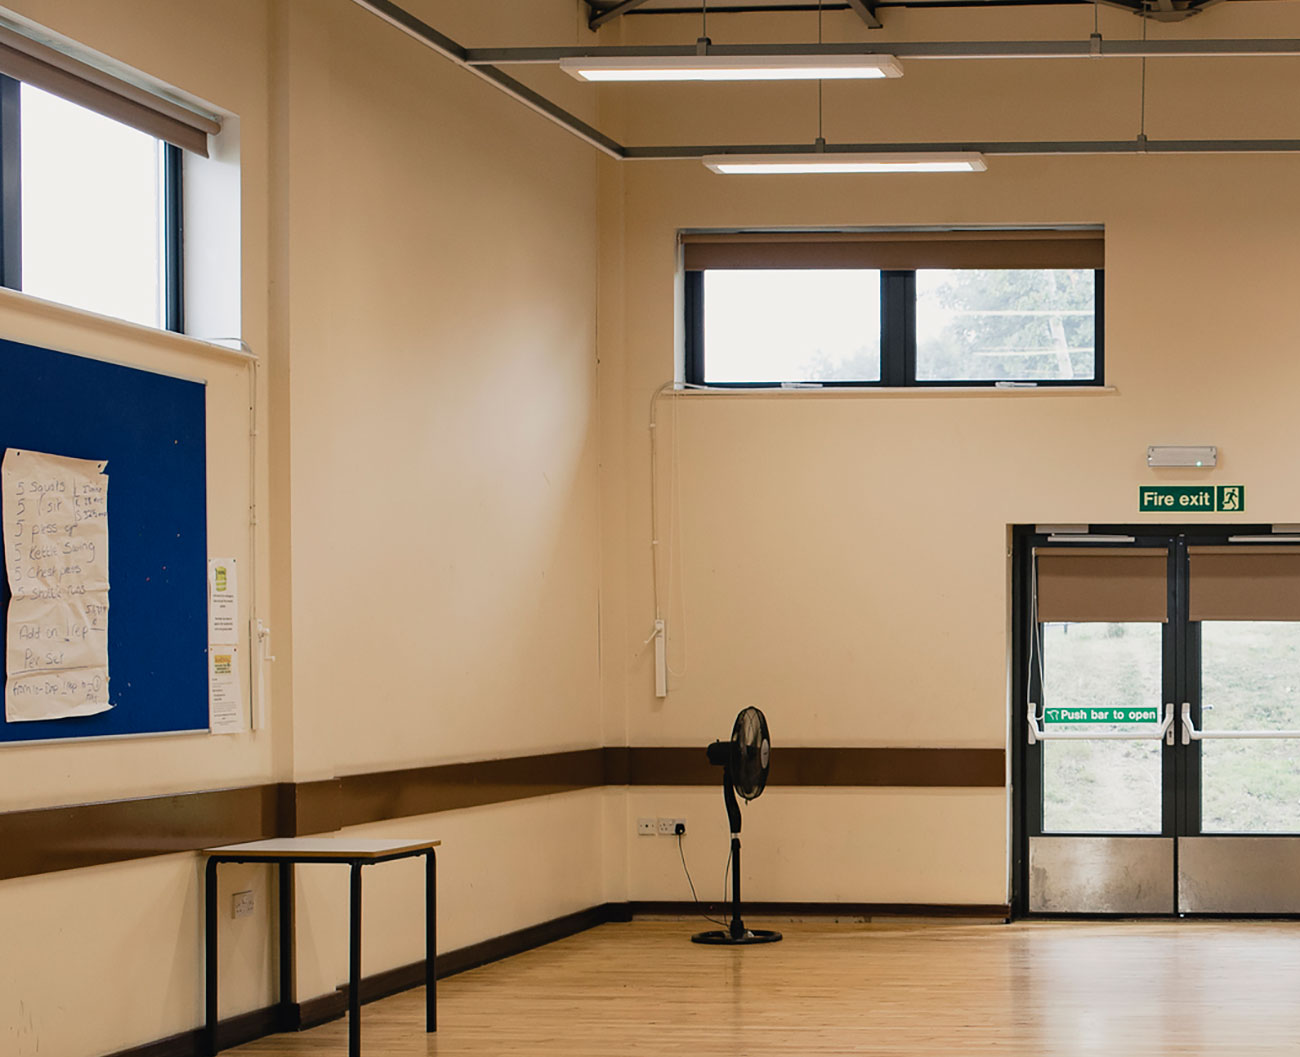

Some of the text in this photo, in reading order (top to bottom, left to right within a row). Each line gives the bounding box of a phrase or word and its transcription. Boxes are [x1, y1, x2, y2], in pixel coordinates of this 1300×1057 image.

[16, 481, 24, 496] 5
[16, 497, 25, 516] 5
[1143, 491, 1211, 506] Fire exit
[14, 519, 25, 537] 5
[14, 542, 22, 561] 5
[15, 566, 22, 581] 5
[19, 624, 40, 640] Add
[24, 648, 40, 669] Per
[1060, 709, 1156, 721] Push bar to open
